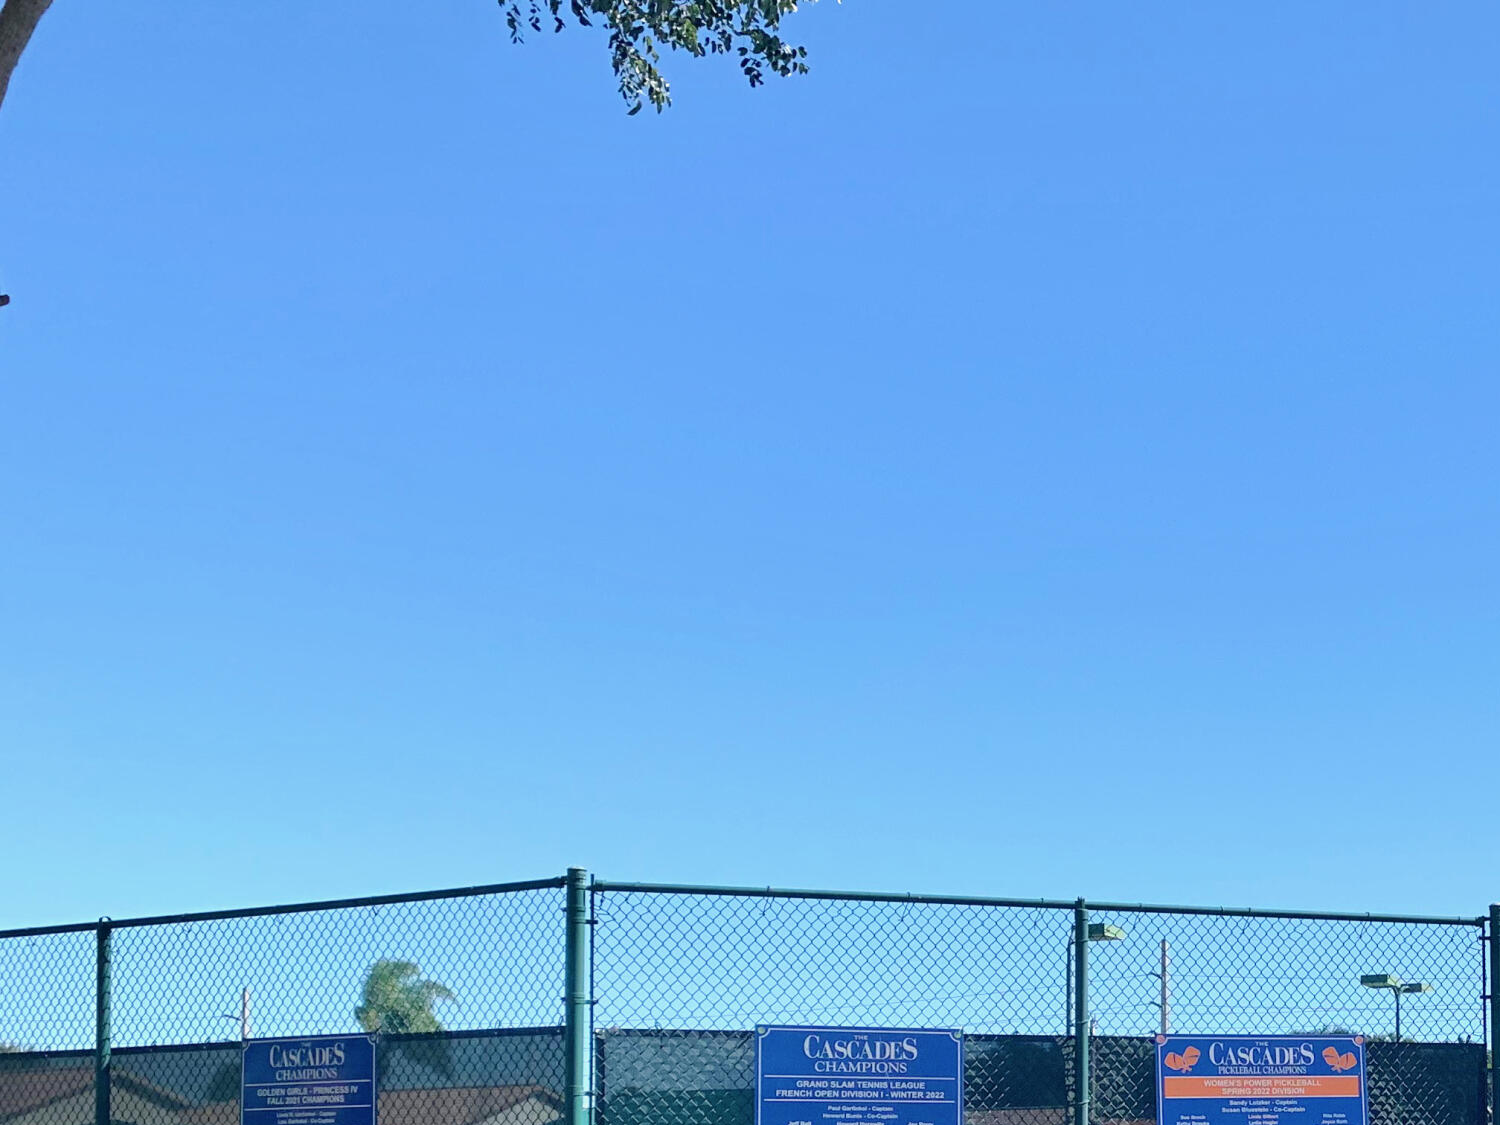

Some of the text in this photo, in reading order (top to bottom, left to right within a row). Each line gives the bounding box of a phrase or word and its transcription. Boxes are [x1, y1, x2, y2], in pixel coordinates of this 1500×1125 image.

[803, 1034, 918, 1061] CASCADES
[269, 1042, 345, 1068] CASCADES
[1209, 1041, 1315, 1066] CASCADES
[814, 1061, 908, 1074] CHAMPIONS
[1218, 1066, 1307, 1075] PICKLEBALL CHAMPIONS
[275, 1068, 338, 1081] CHAMPIONS
[796, 1080, 926, 1089] GRAND SLAM TENNIS LEAGUE
[1203, 1079, 1321, 1087] WOMEN'S POWER PICKLEBALL
[776, 1089, 812, 1098] FRENCH
[814, 1089, 839, 1098] OPEN
[841, 1090, 879, 1099] DIVISION
[890, 1090, 924, 1099] WINTER
[925, 1090, 944, 1099] 2022
[1222, 1087, 1305, 1095] SPRING 2022 DIVISION
